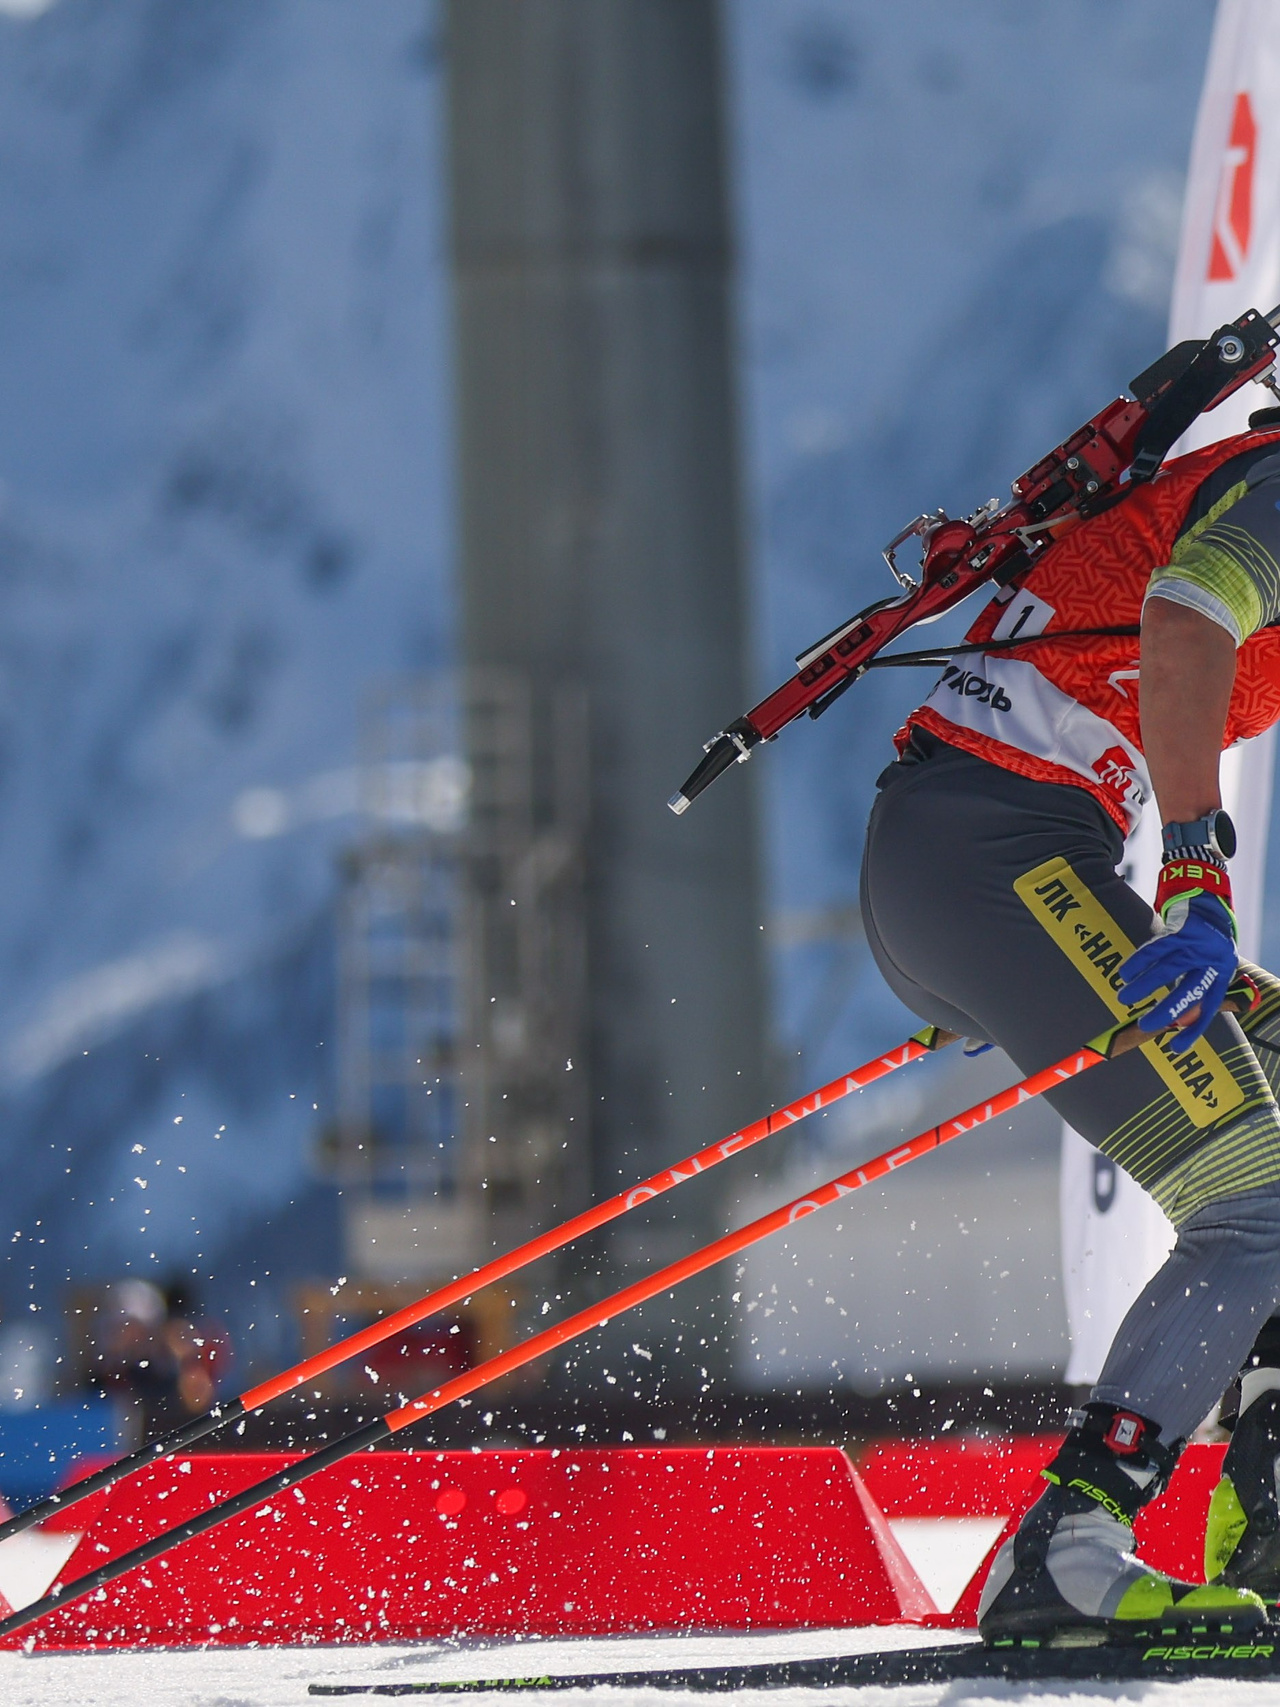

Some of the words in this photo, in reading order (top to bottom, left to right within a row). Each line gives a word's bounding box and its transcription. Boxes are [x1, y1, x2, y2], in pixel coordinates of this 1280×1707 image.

[1008, 605, 1035, 639] 1
[1162, 864, 1221, 885] LEKI
[1034, 878, 1082, 922] ЛК
[1142, 1645, 1274, 1661] FISCHER
